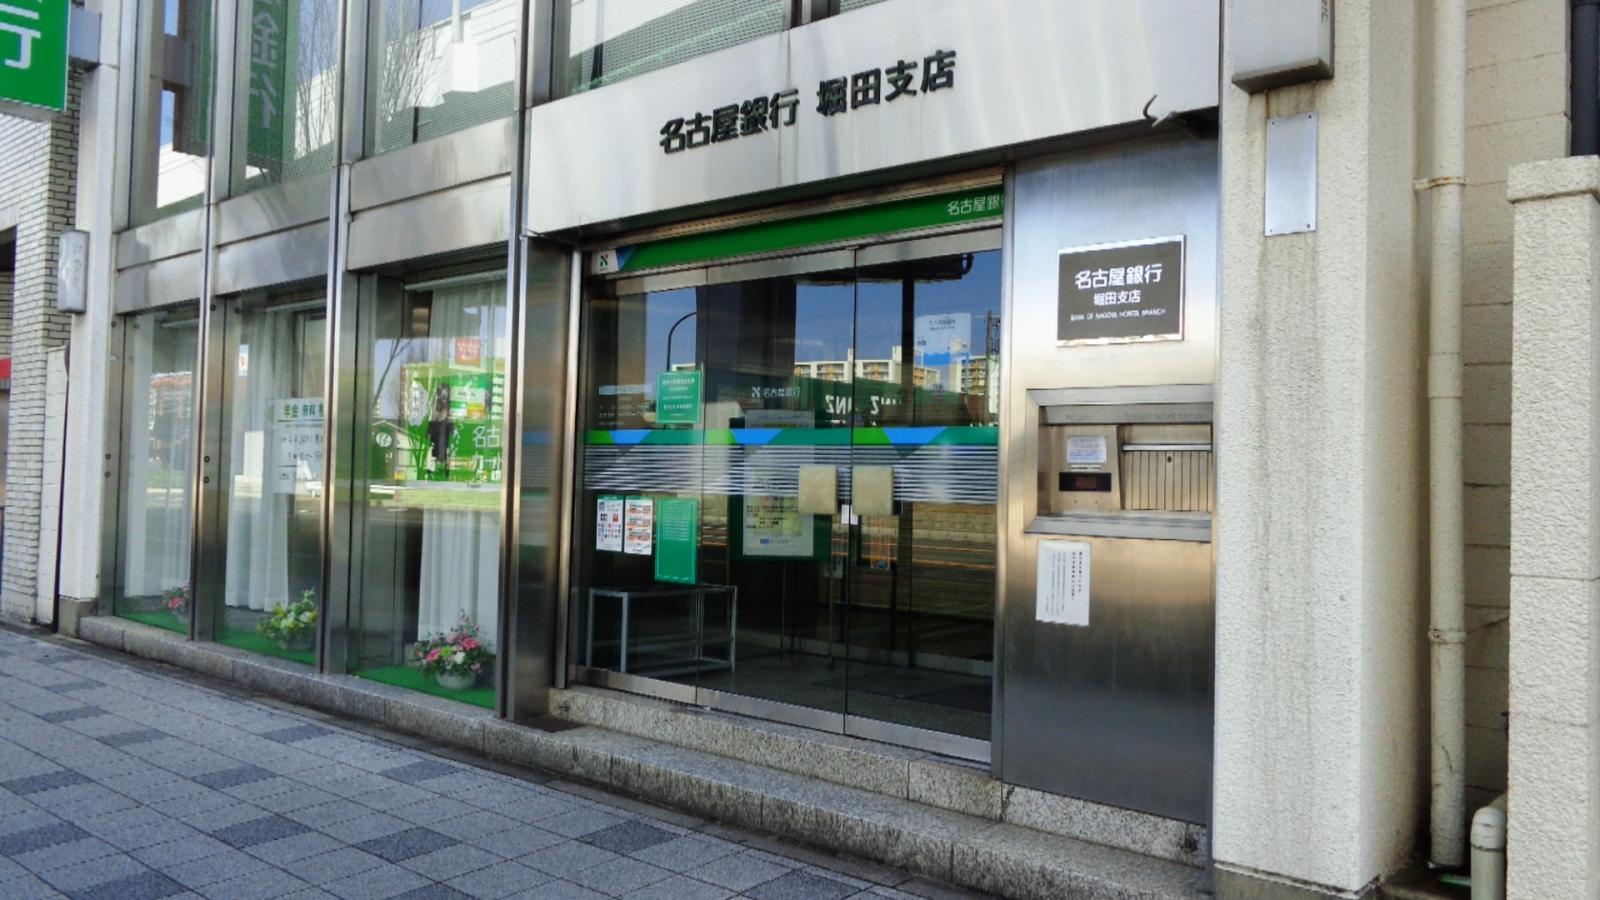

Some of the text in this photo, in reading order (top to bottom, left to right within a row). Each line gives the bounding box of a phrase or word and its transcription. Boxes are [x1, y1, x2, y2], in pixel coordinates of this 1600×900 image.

[659, 49, 956, 154] 名古屋銀行 堀田支店
[947, 192, 1004, 215] 名古屋銀
[1075, 263, 1163, 290] 名古屋銀行
[1093, 289, 1141, 306] 堀田支店
[1086, 312, 1094, 320] OF
[1095, 311, 1118, 319] NAGOYA
[1119, 309, 1140, 318] HORITA
[1141, 308, 1166, 317] BRANCH
